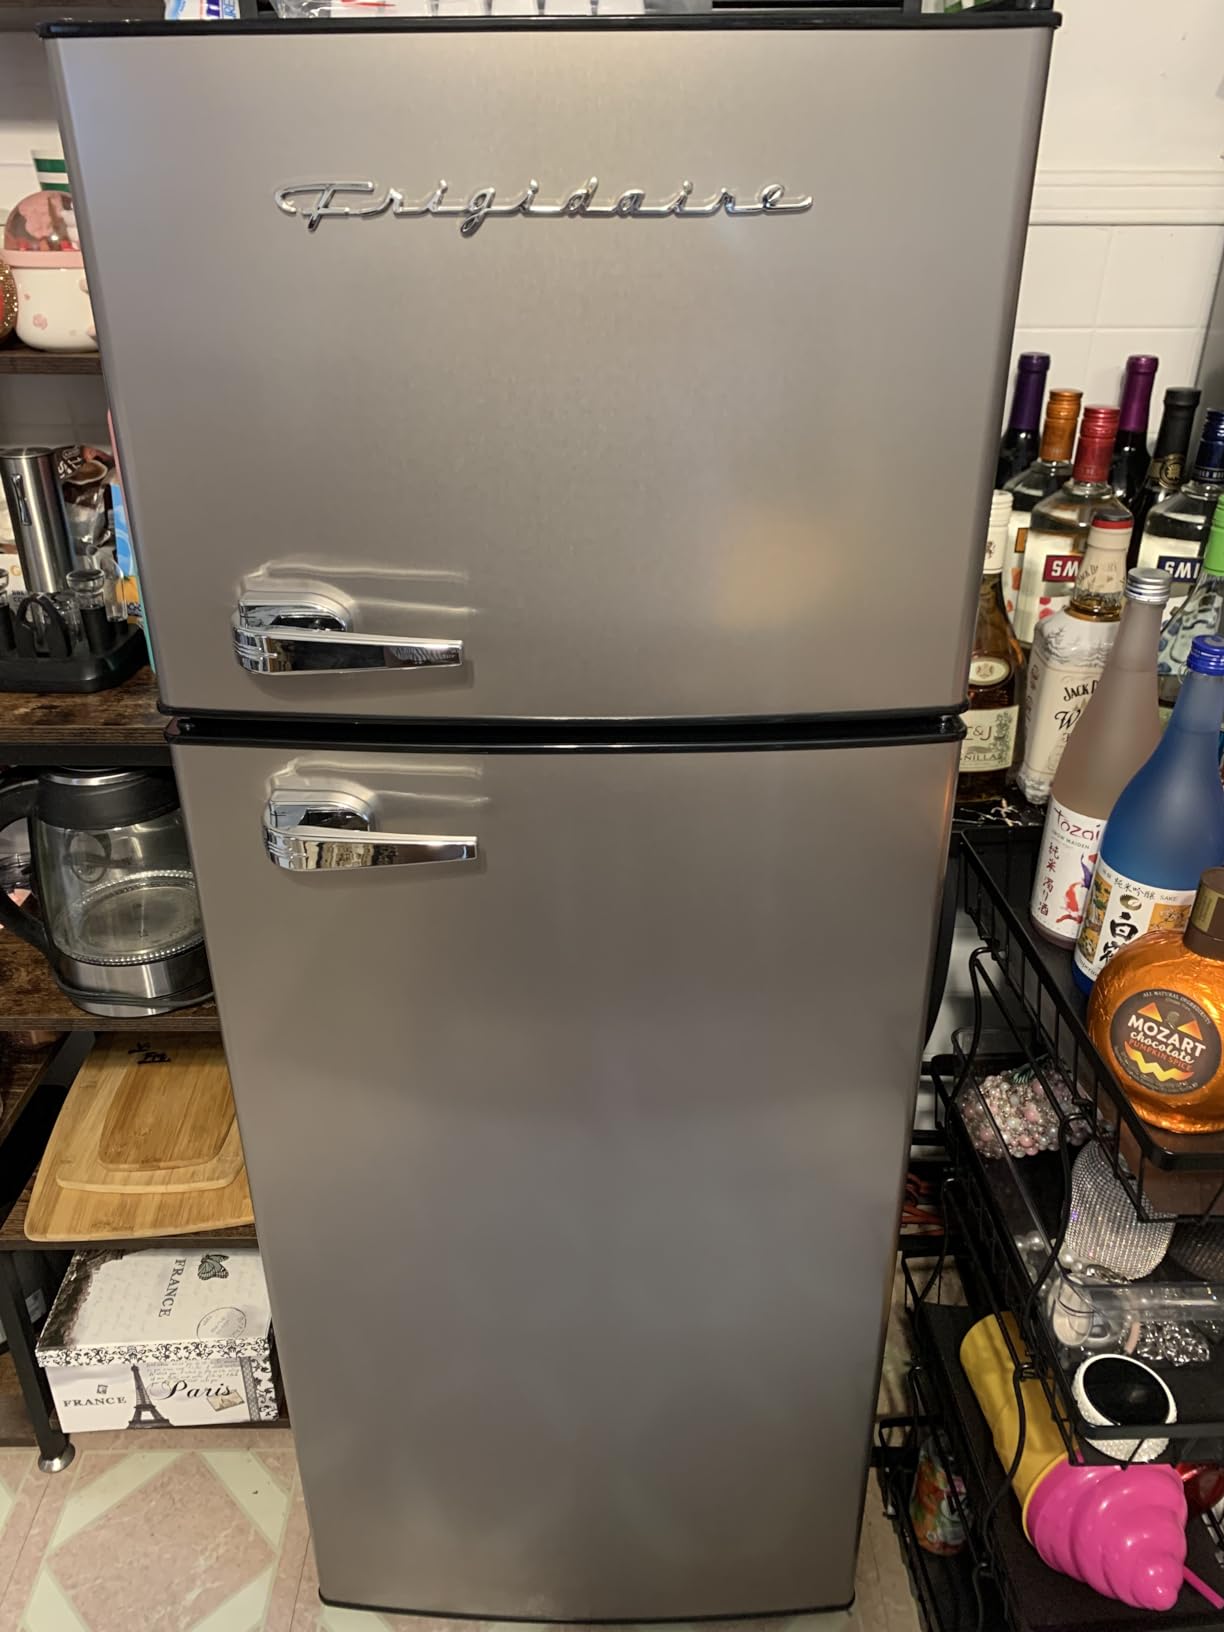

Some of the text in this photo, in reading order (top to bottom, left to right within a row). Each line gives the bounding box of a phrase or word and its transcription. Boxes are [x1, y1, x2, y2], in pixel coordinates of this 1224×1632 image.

[274, 176, 814, 237] Frigidaire
[1063, 683, 1089, 702] JACK
[960, 753, 998, 761] NILLA
[1054, 807, 1101, 841] Tozai
[1127, 1014, 1206, 1058] MOZART
[1130, 1031, 1195, 1065] chocolate
[1128, 1039, 1168, 1061] PUMPKIN
[1169, 1055, 1194, 1071] SPICE
[158, 1257, 187, 1318] FRANCE
[63, 1396, 127, 1407] FRANCE
[159, 1380, 231, 1400] Paris
